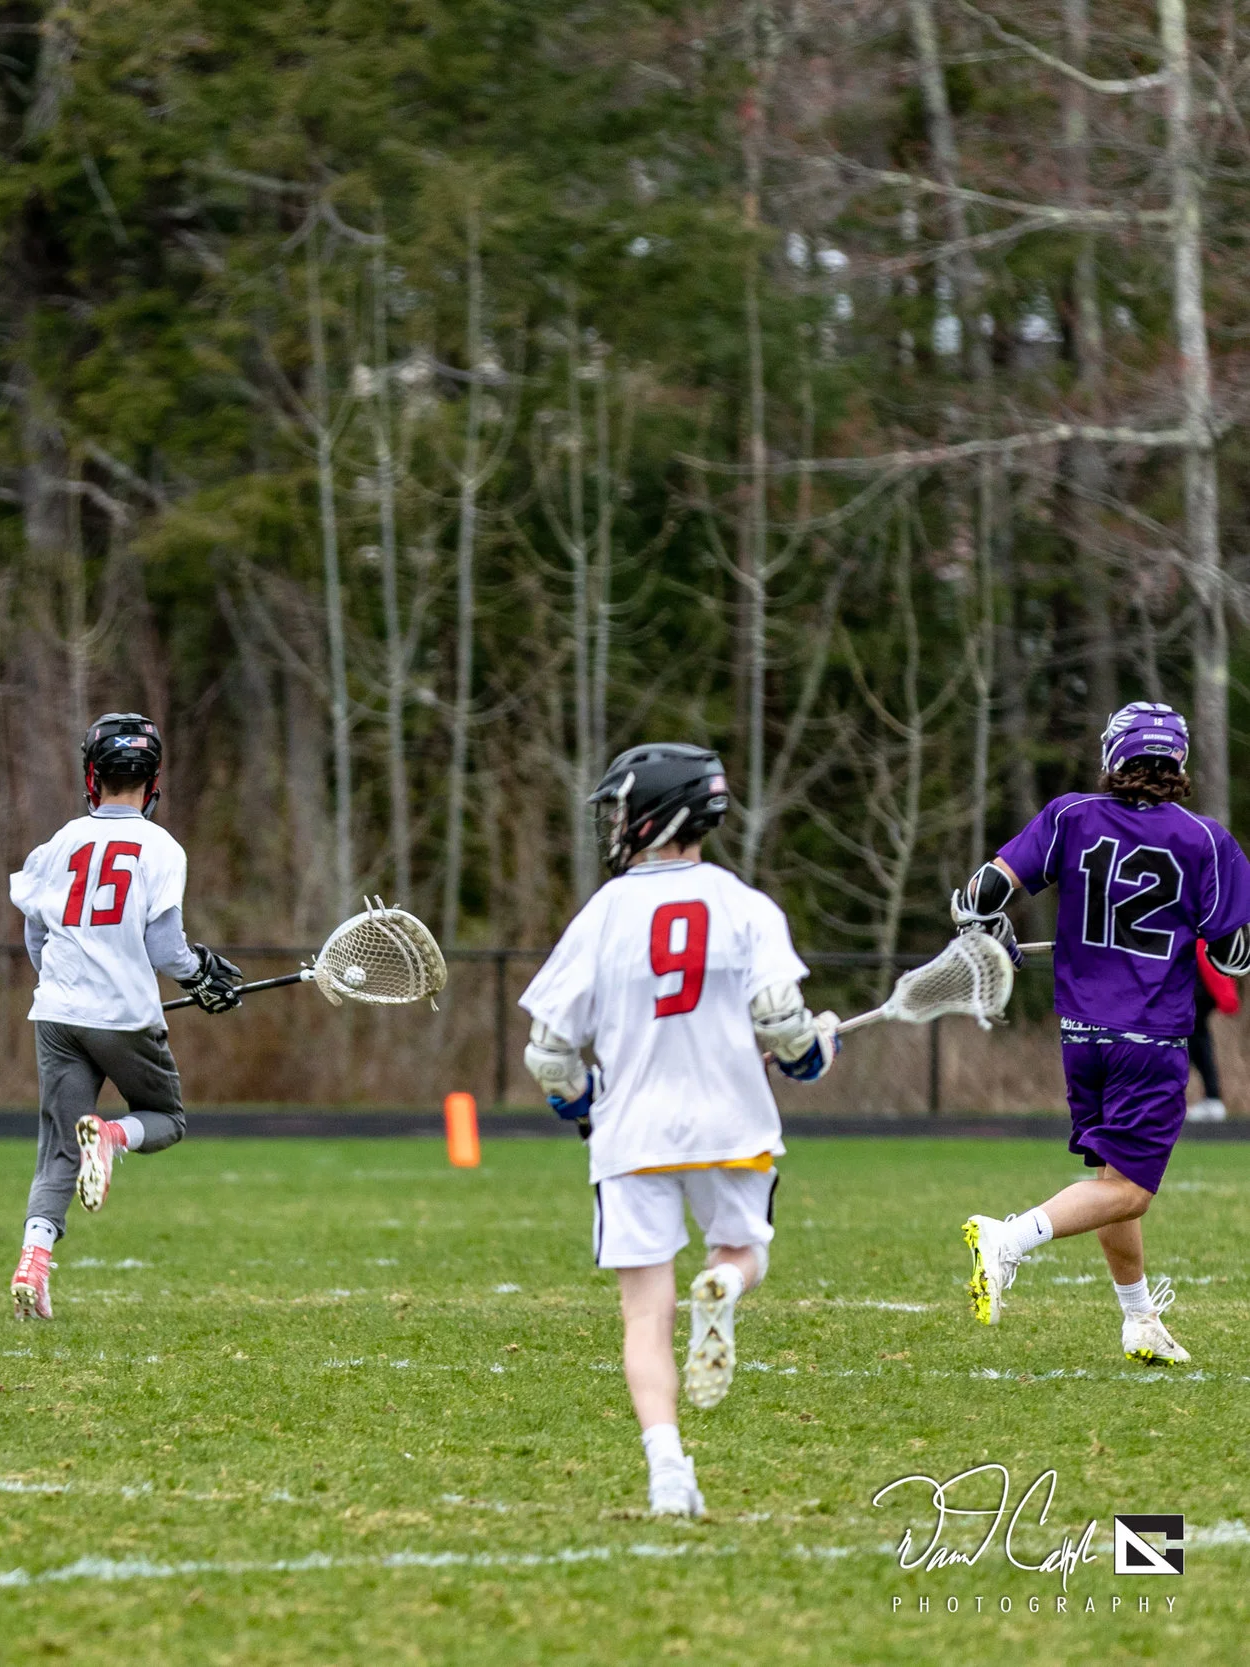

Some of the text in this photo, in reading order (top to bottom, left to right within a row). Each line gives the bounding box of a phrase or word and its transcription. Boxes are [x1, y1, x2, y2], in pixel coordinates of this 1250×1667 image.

[1154, 718, 1163, 726] 12
[62, 841, 142, 927] 15
[1078, 836, 1184, 960] 12
[649, 899, 709, 1019] 9
